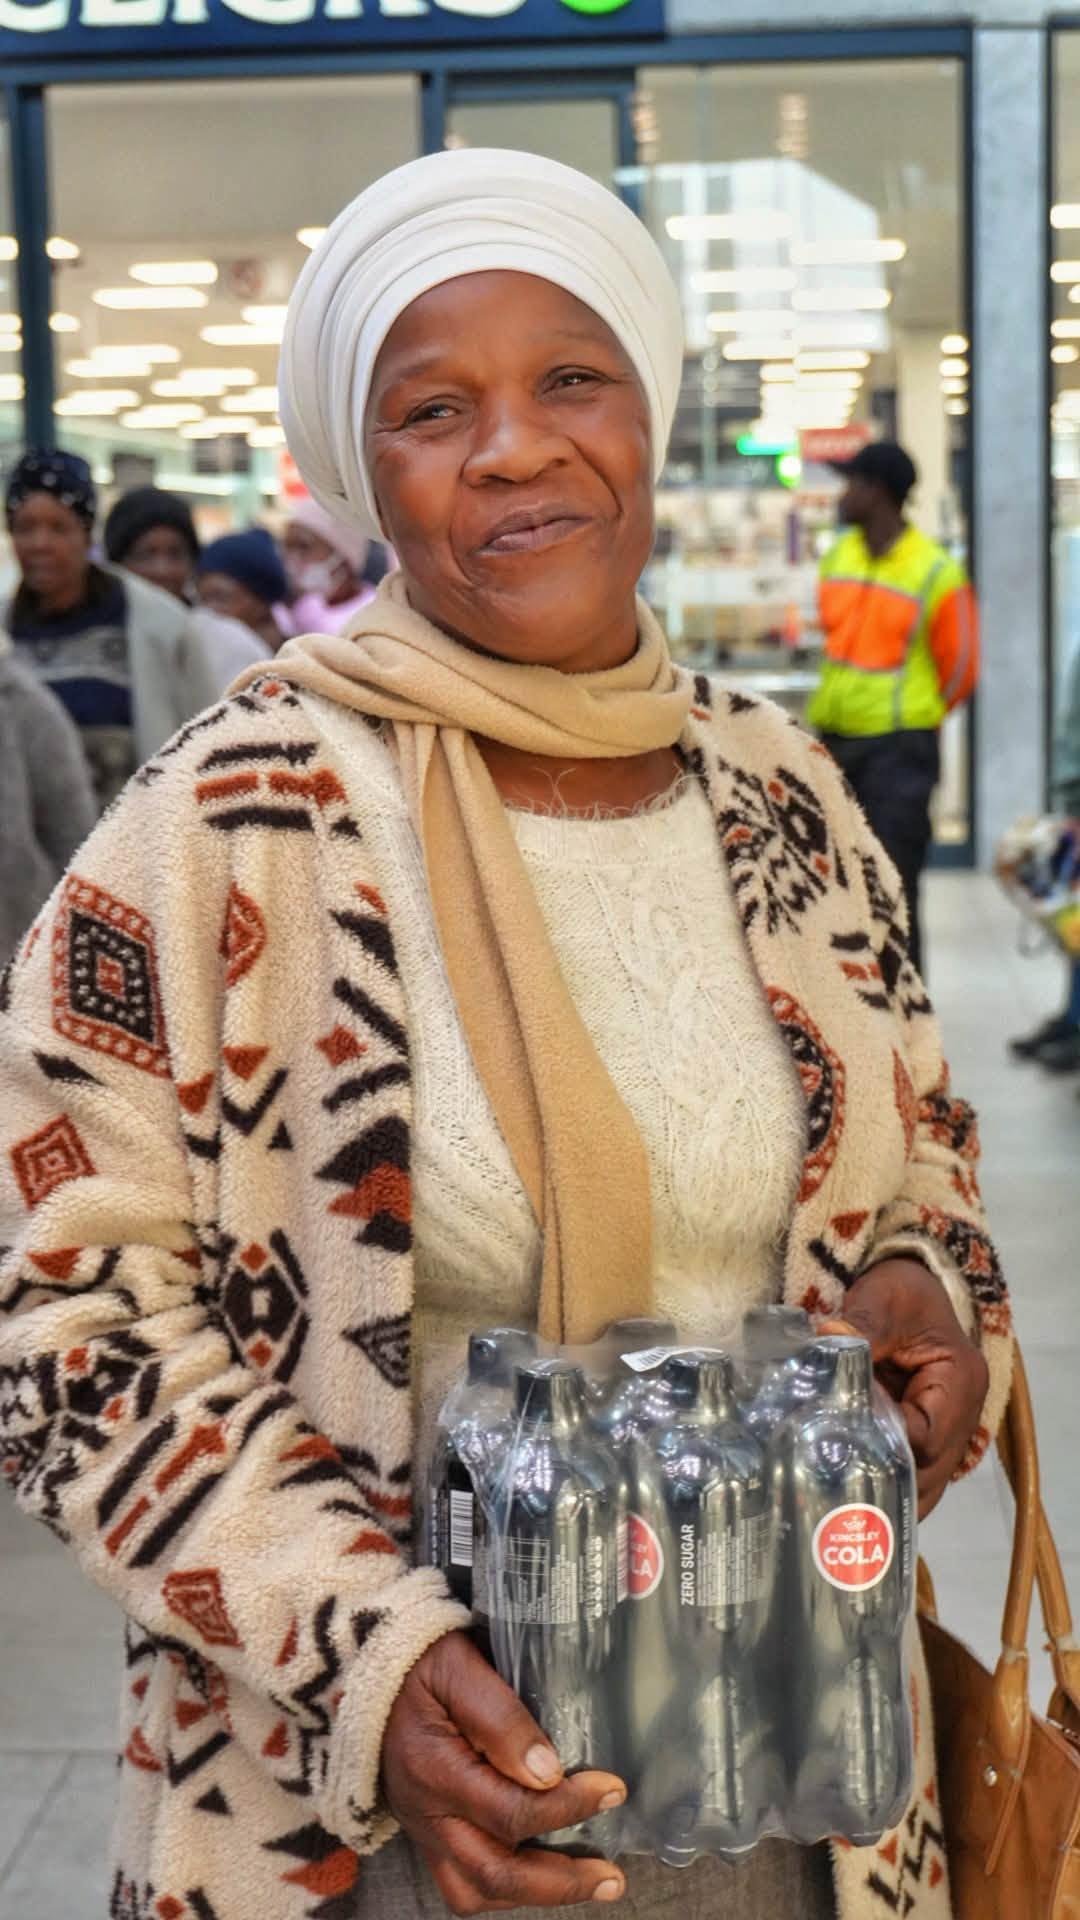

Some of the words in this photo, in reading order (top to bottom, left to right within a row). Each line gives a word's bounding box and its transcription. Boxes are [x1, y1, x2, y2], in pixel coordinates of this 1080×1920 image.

[681, 1523, 695, 1569] SUGAR
[829, 1531, 880, 1543] KINGSLEY
[823, 1543, 885, 1565] COLA
[631, 1557, 654, 1579] LA
[681, 1571, 695, 1606] ZERO
